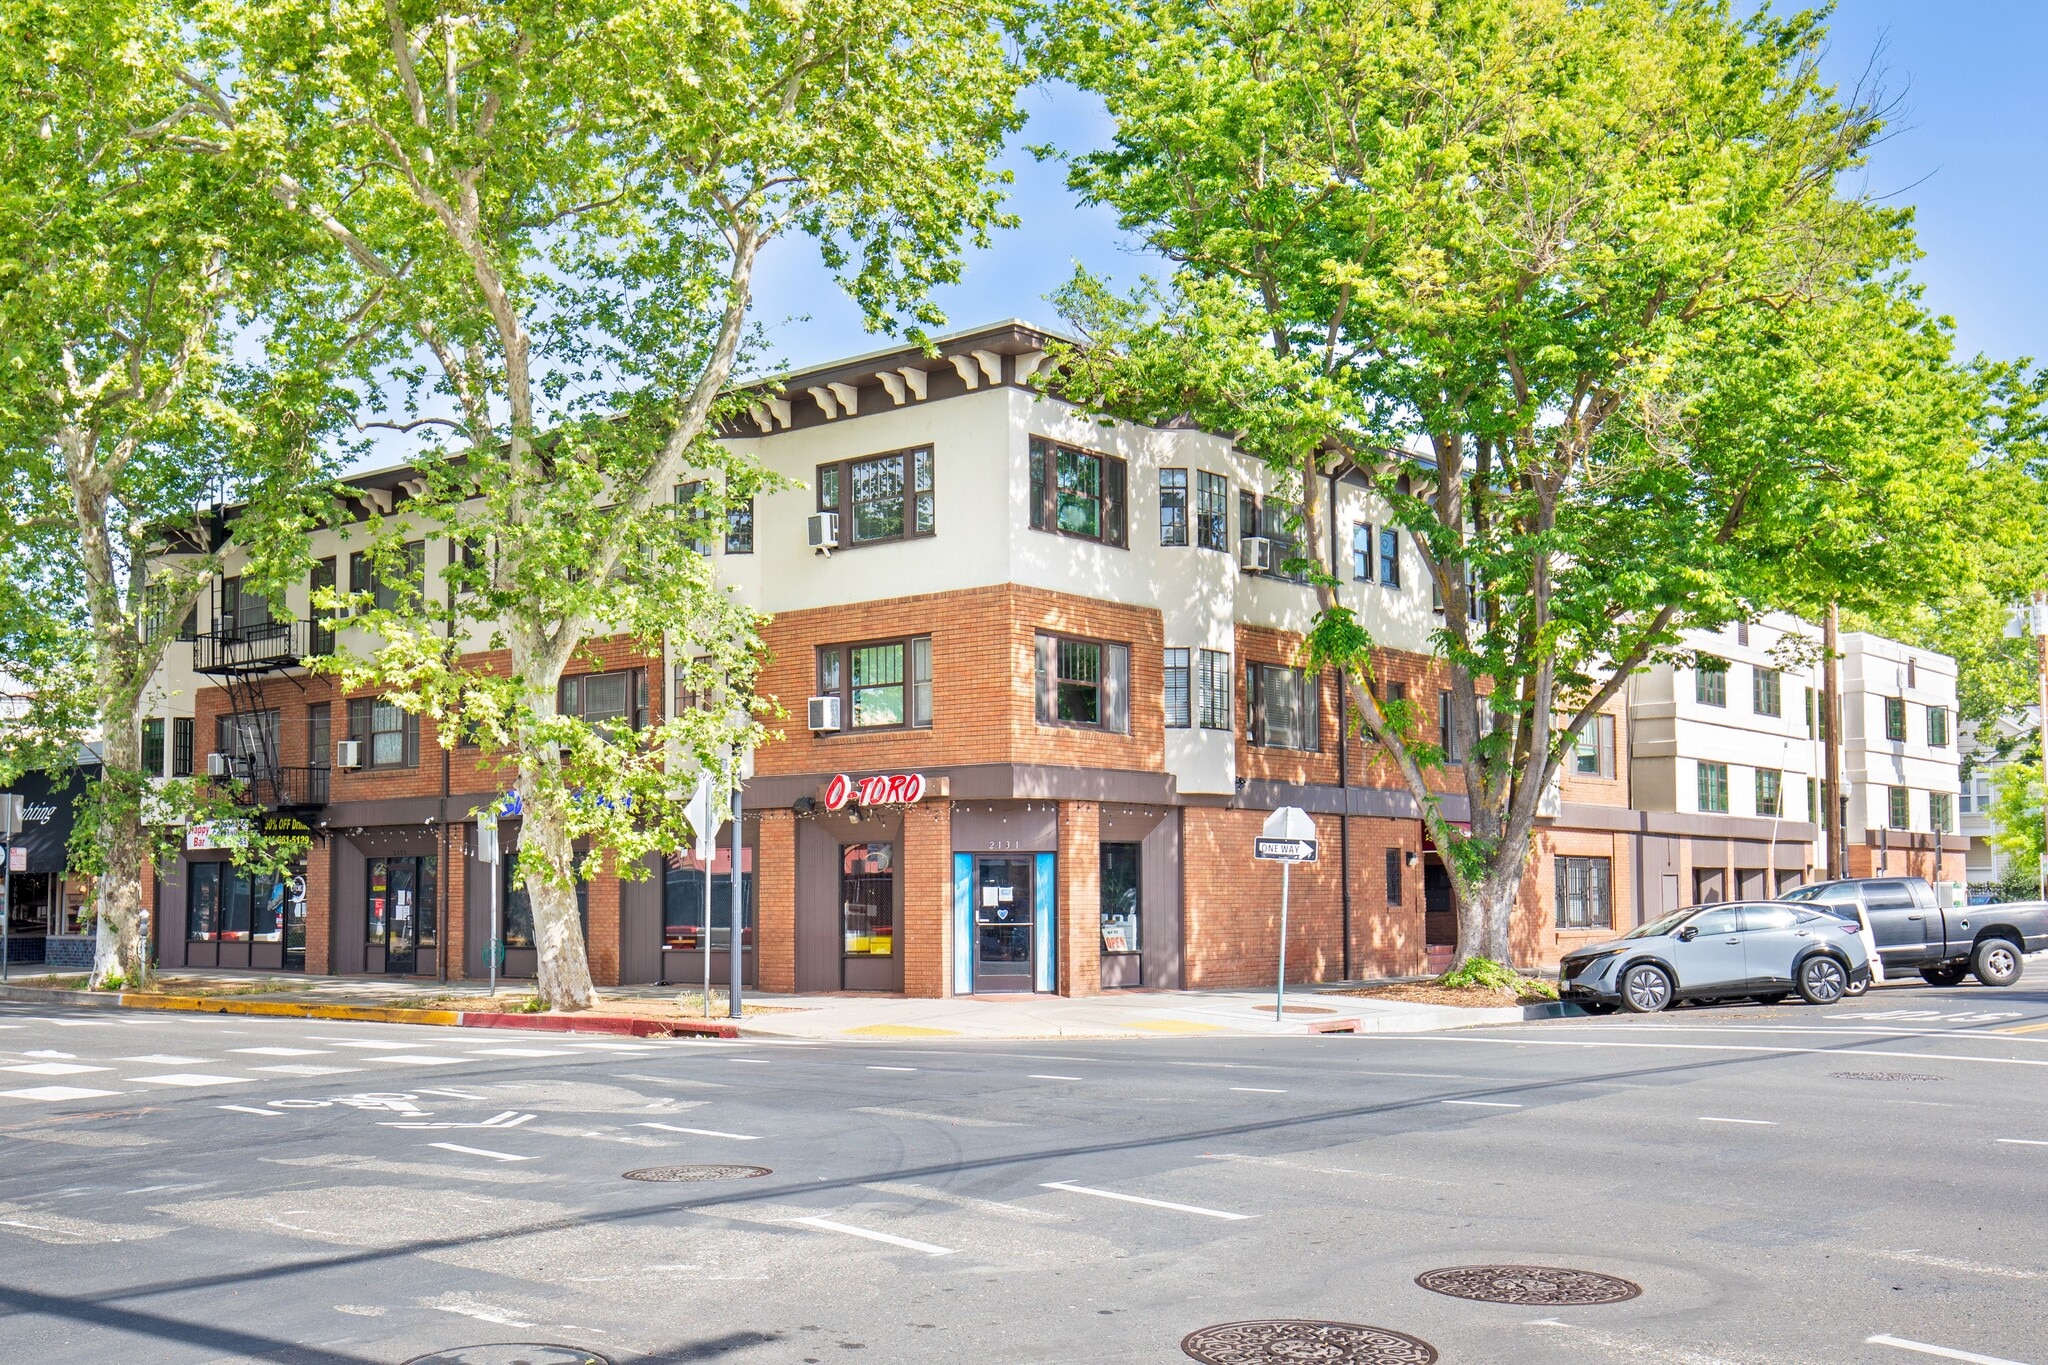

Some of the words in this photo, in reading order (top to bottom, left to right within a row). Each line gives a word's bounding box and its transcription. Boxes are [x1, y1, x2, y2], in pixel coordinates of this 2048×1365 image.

[825, 773, 925, 810] O-TORO
[278, 818, 291, 830] OFF
[193, 837, 205, 847] Bar
[988, 840, 1019, 850] 2131
[1261, 843, 1278, 853] ONE
[1281, 844, 1300, 854] WAY
[1106, 937, 1125, 949] OPEN
